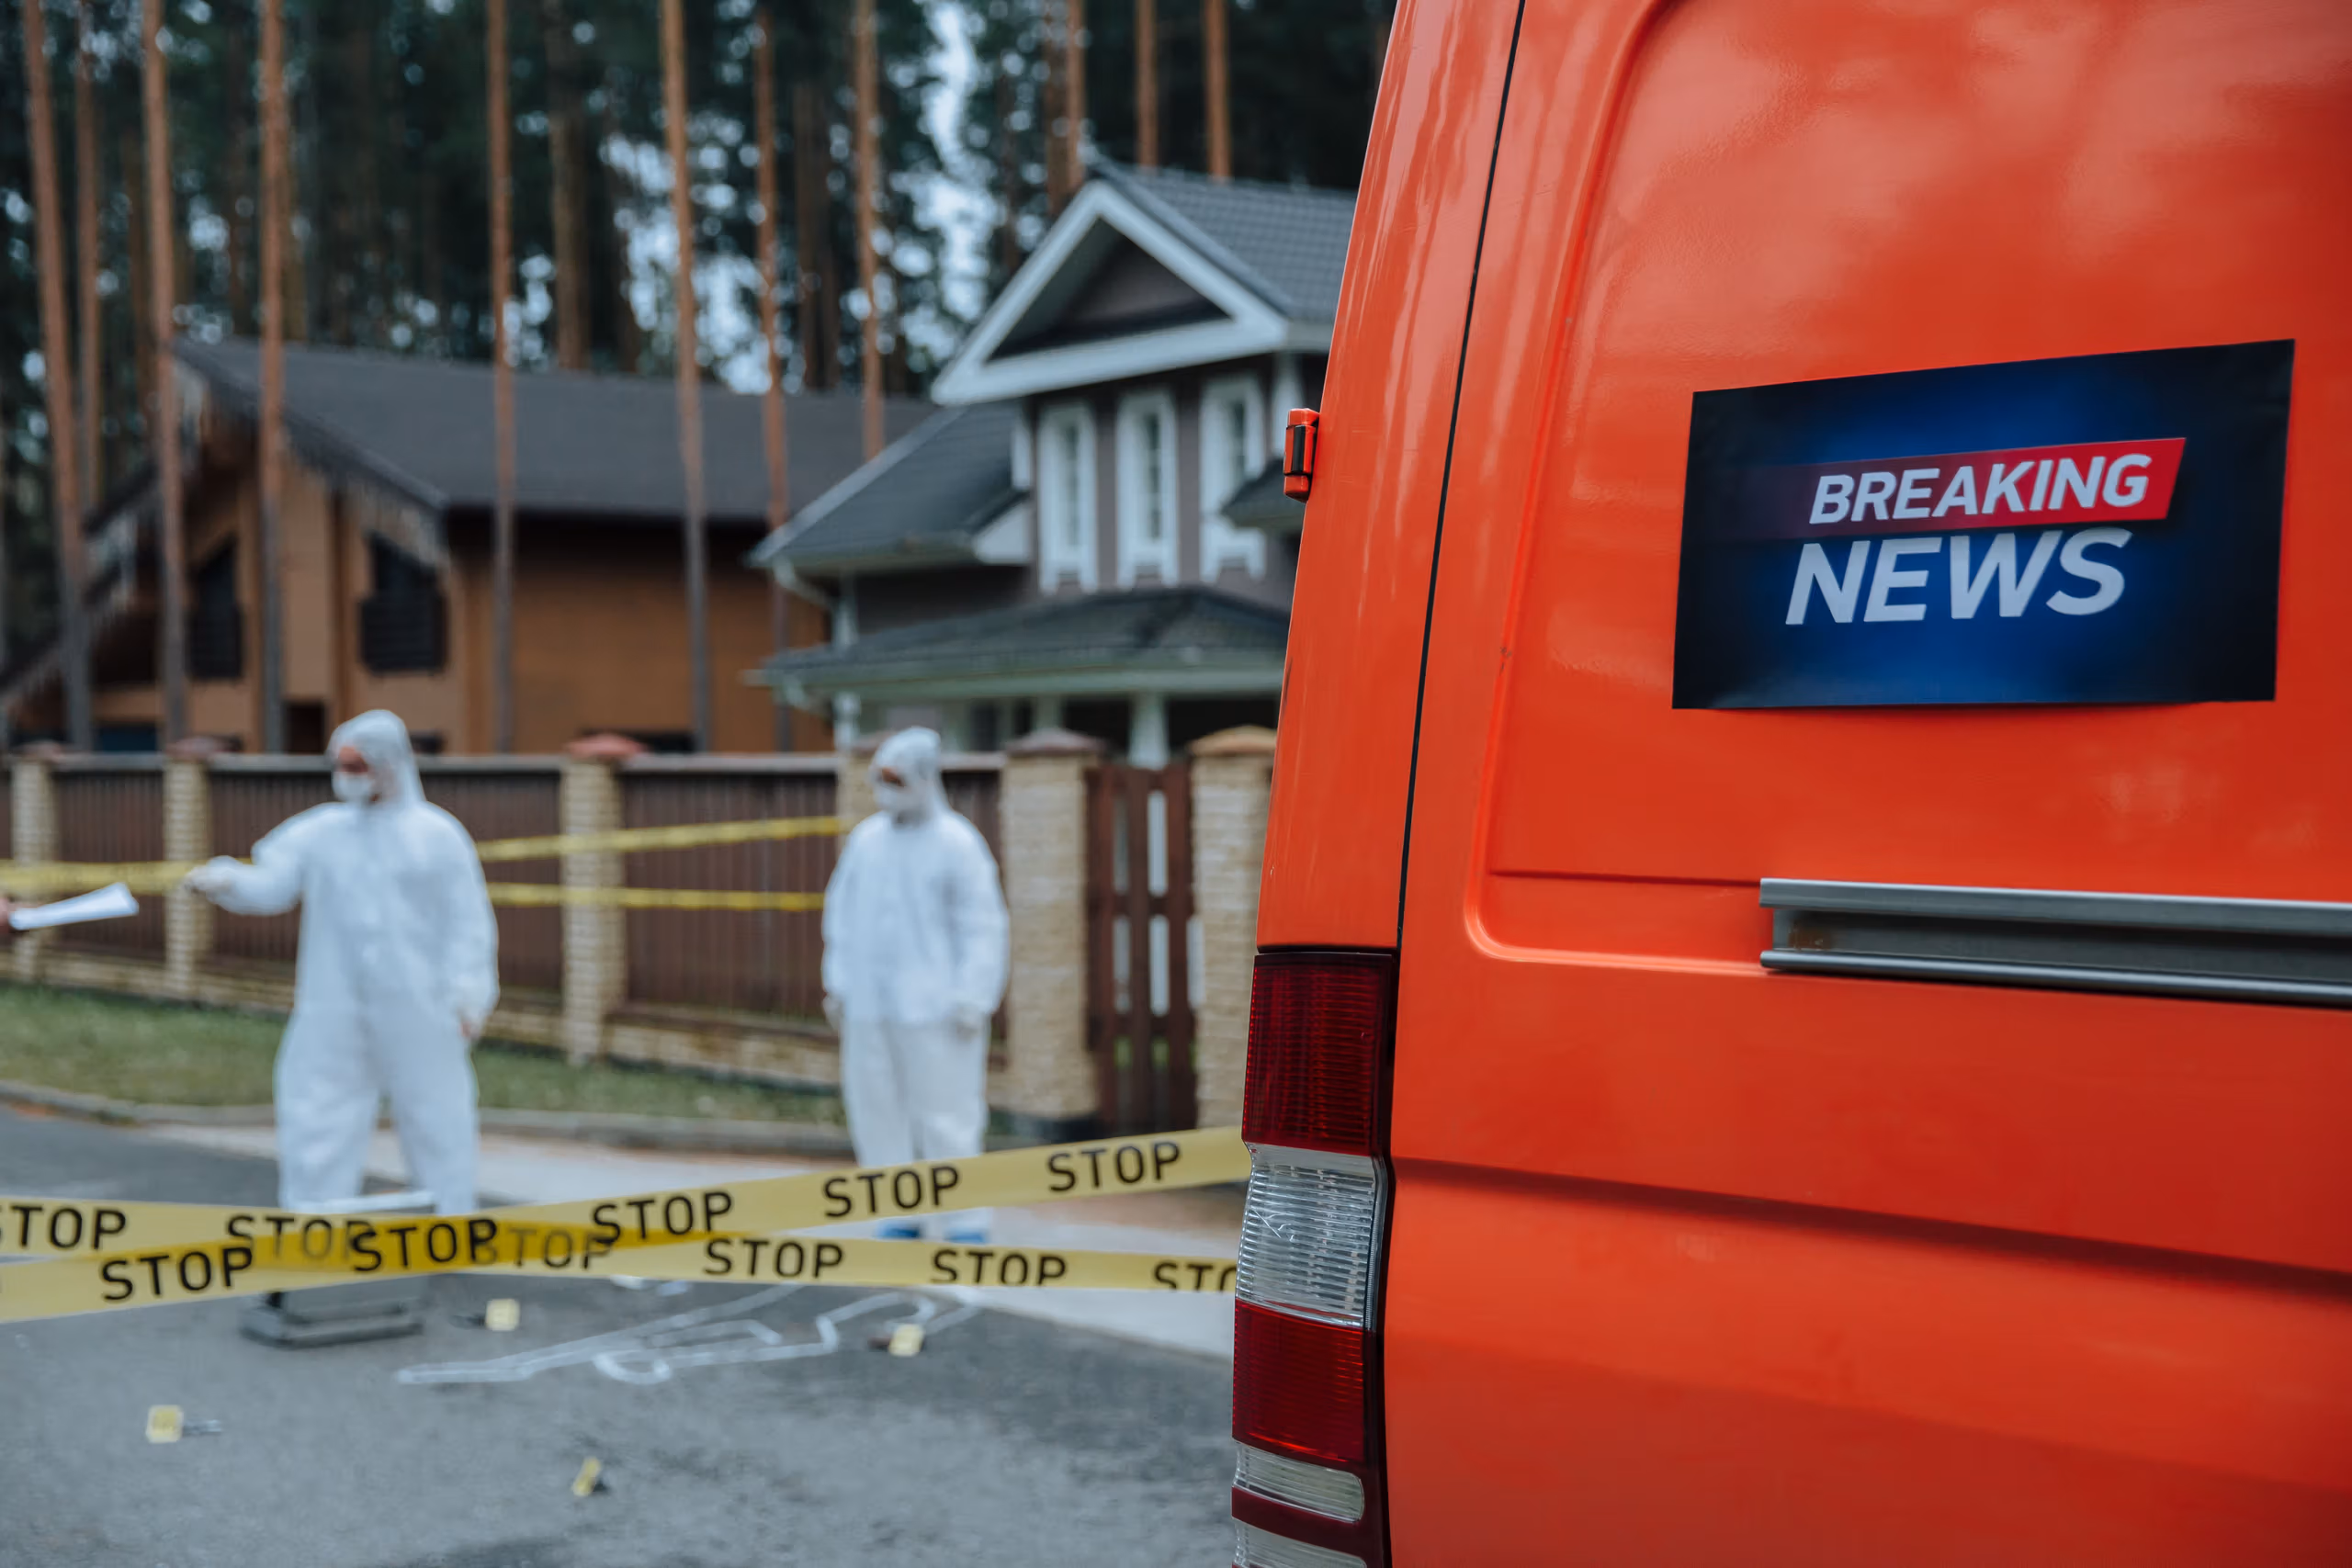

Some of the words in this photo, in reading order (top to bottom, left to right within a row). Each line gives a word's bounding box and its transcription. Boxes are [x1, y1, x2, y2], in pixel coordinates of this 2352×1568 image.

[1809, 453, 2153, 525] BREAKING
[1785, 526, 2134, 626] NEWS
[0, 1204, 127, 1250] TOP
[704, 1237, 843, 1278] STOP
[930, 1248, 1066, 1286] STOP
[101, 1247, 253, 1301] STOP
[350, 1219, 498, 1271] STOP
[593, 1191, 732, 1245] STOP
[823, 1166, 959, 1218] STOP
[1047, 1141, 1181, 1191] STOP
